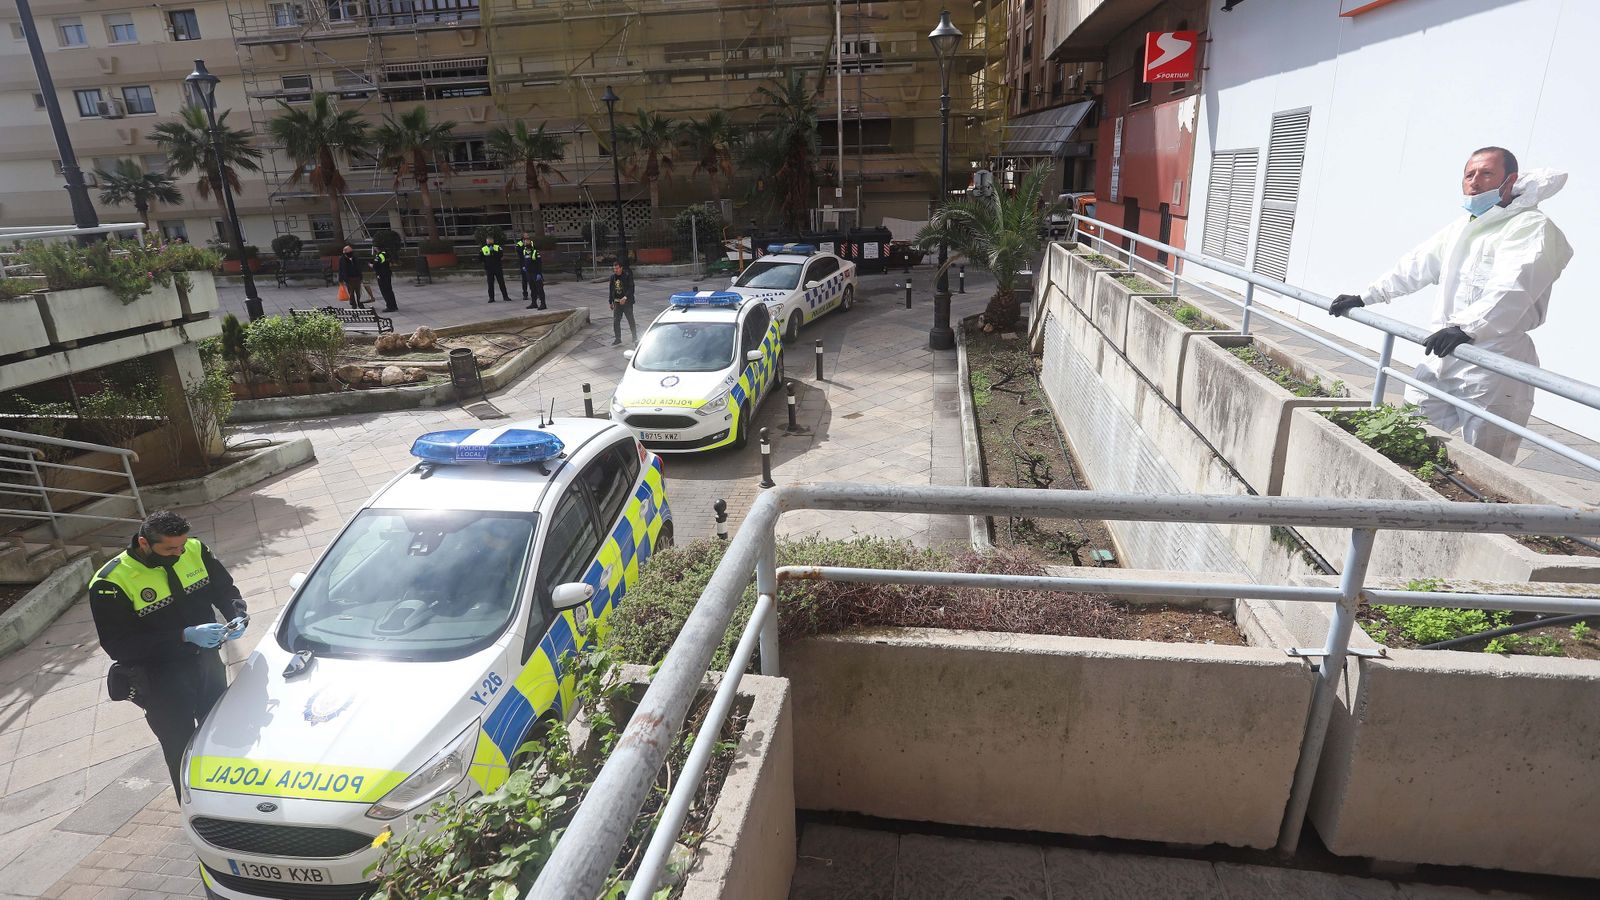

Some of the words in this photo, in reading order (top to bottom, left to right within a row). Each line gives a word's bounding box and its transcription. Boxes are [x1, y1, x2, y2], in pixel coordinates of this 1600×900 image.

[470, 671, 503, 706] Y-26
[241, 862, 282, 880] 1309
[288, 867, 324, 882] KXB
